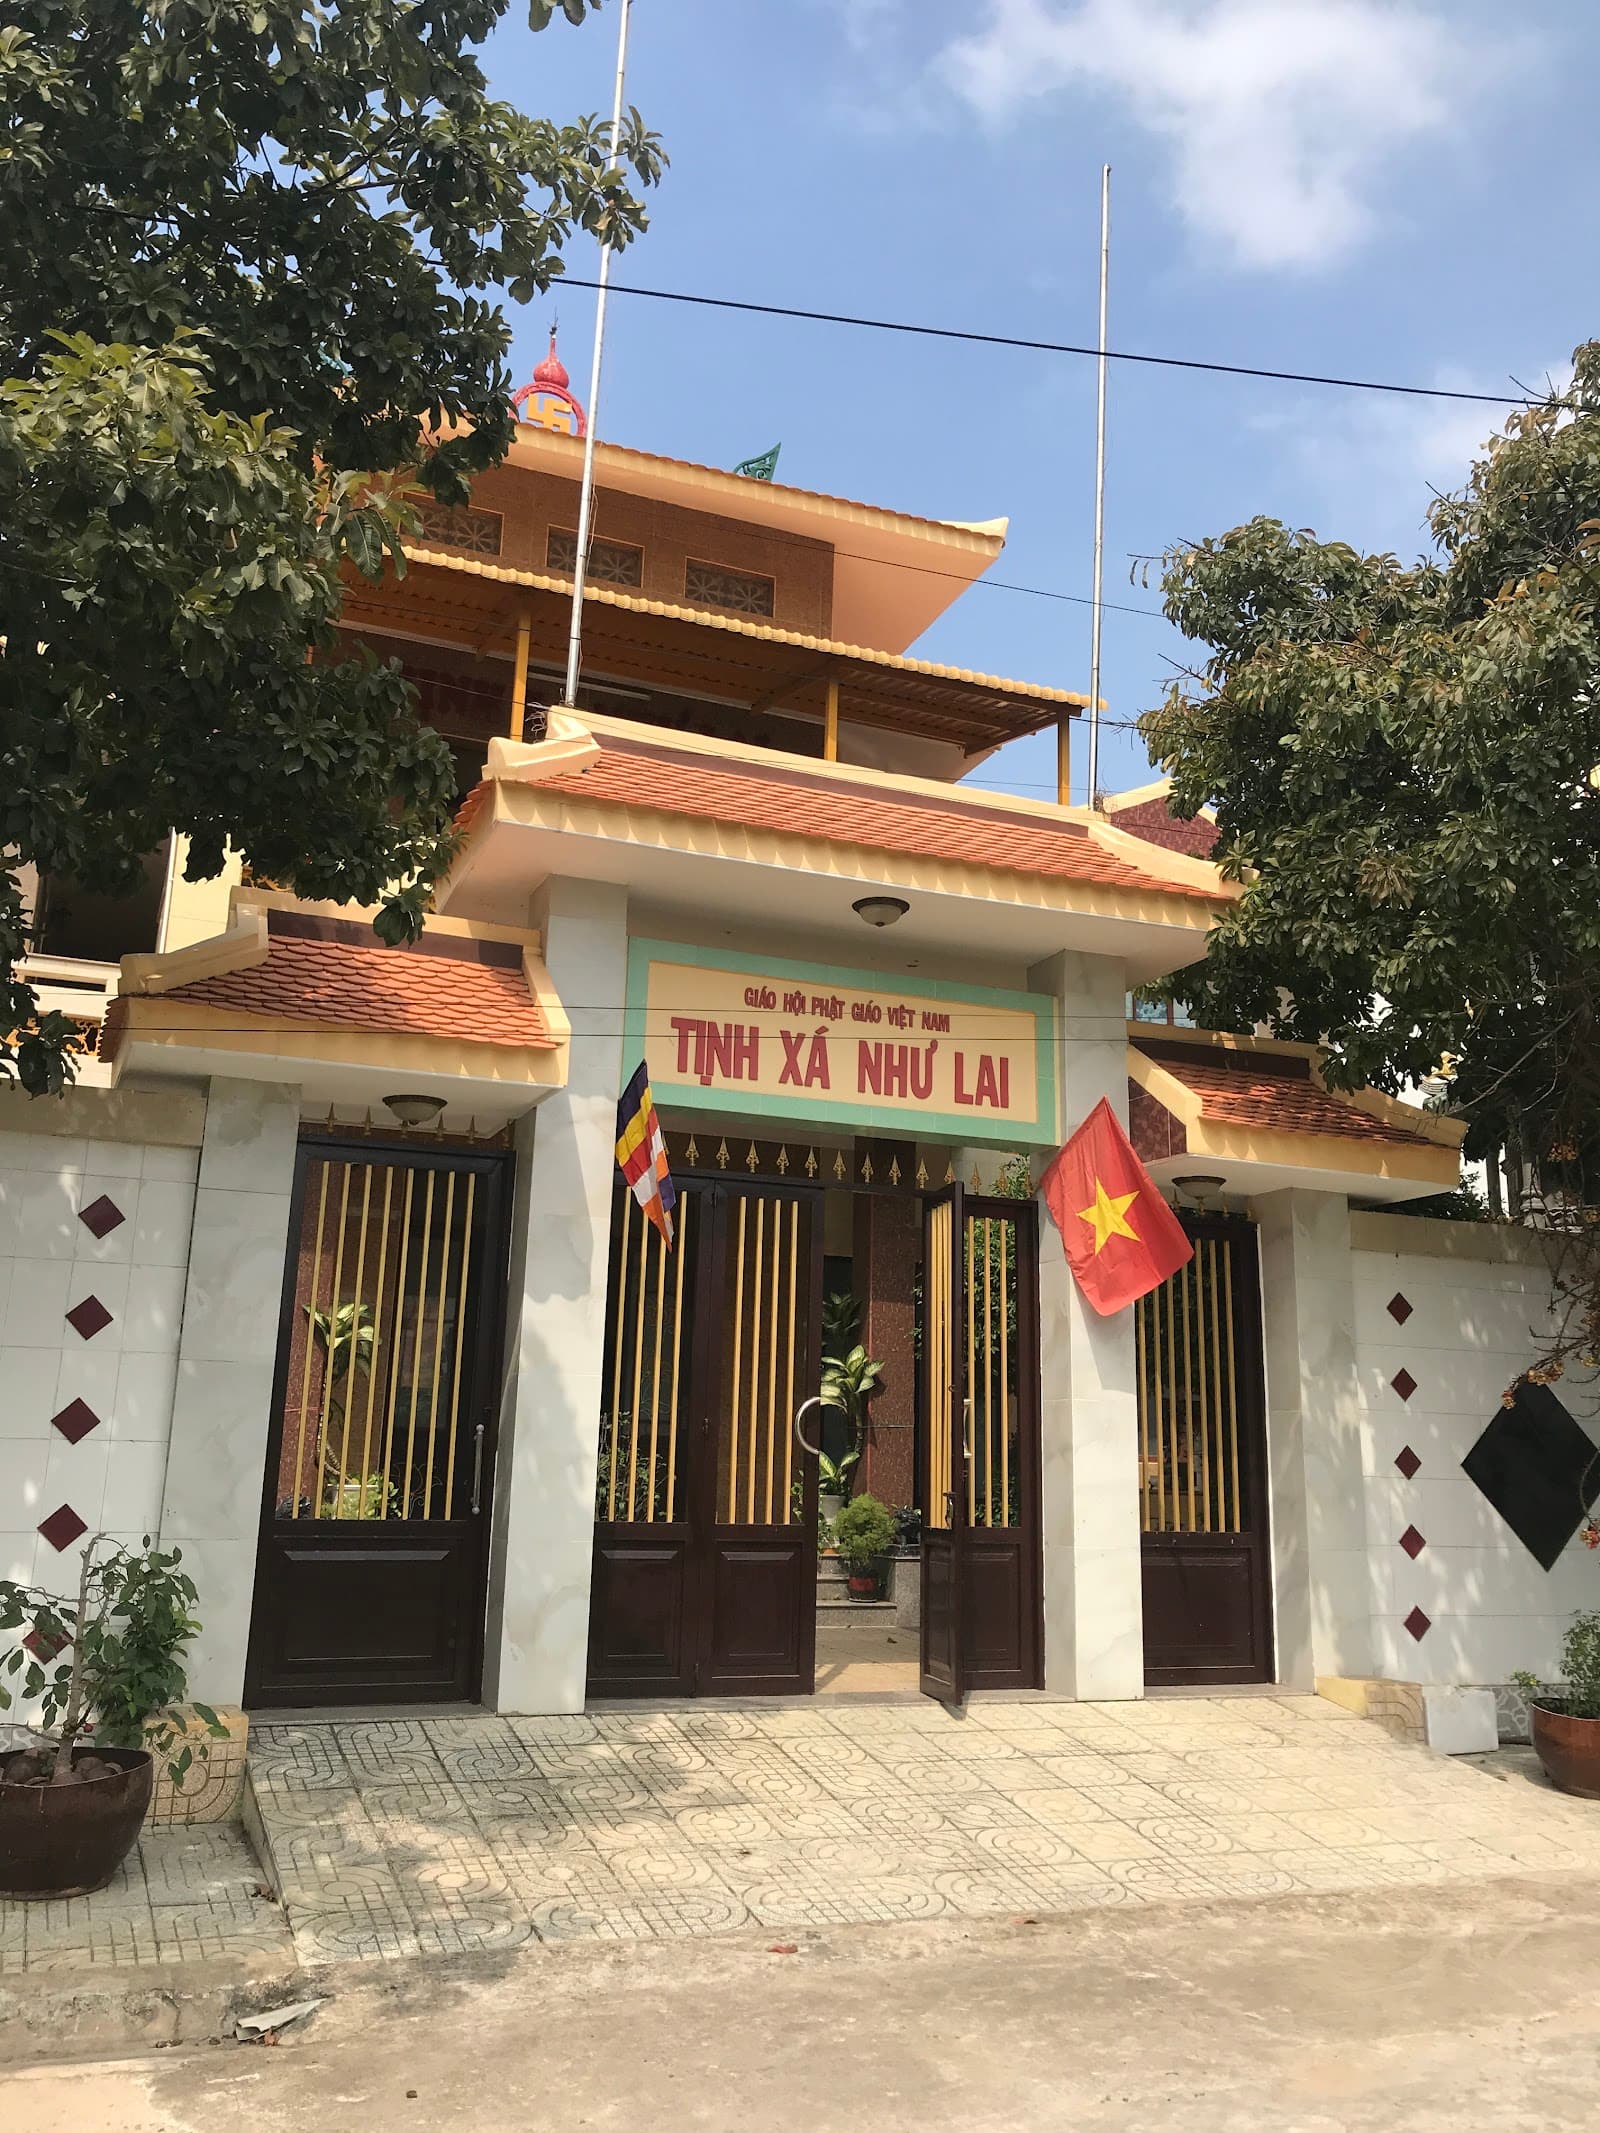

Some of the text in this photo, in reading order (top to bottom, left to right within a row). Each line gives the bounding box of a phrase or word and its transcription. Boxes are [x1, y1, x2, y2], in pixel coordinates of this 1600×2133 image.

[744, 986, 950, 1032] GIÁO HỘI PHẬT GIÁO VIỆT NAM
[671, 1017, 1010, 1109] TỊNH XÁ NHƯ LAI
